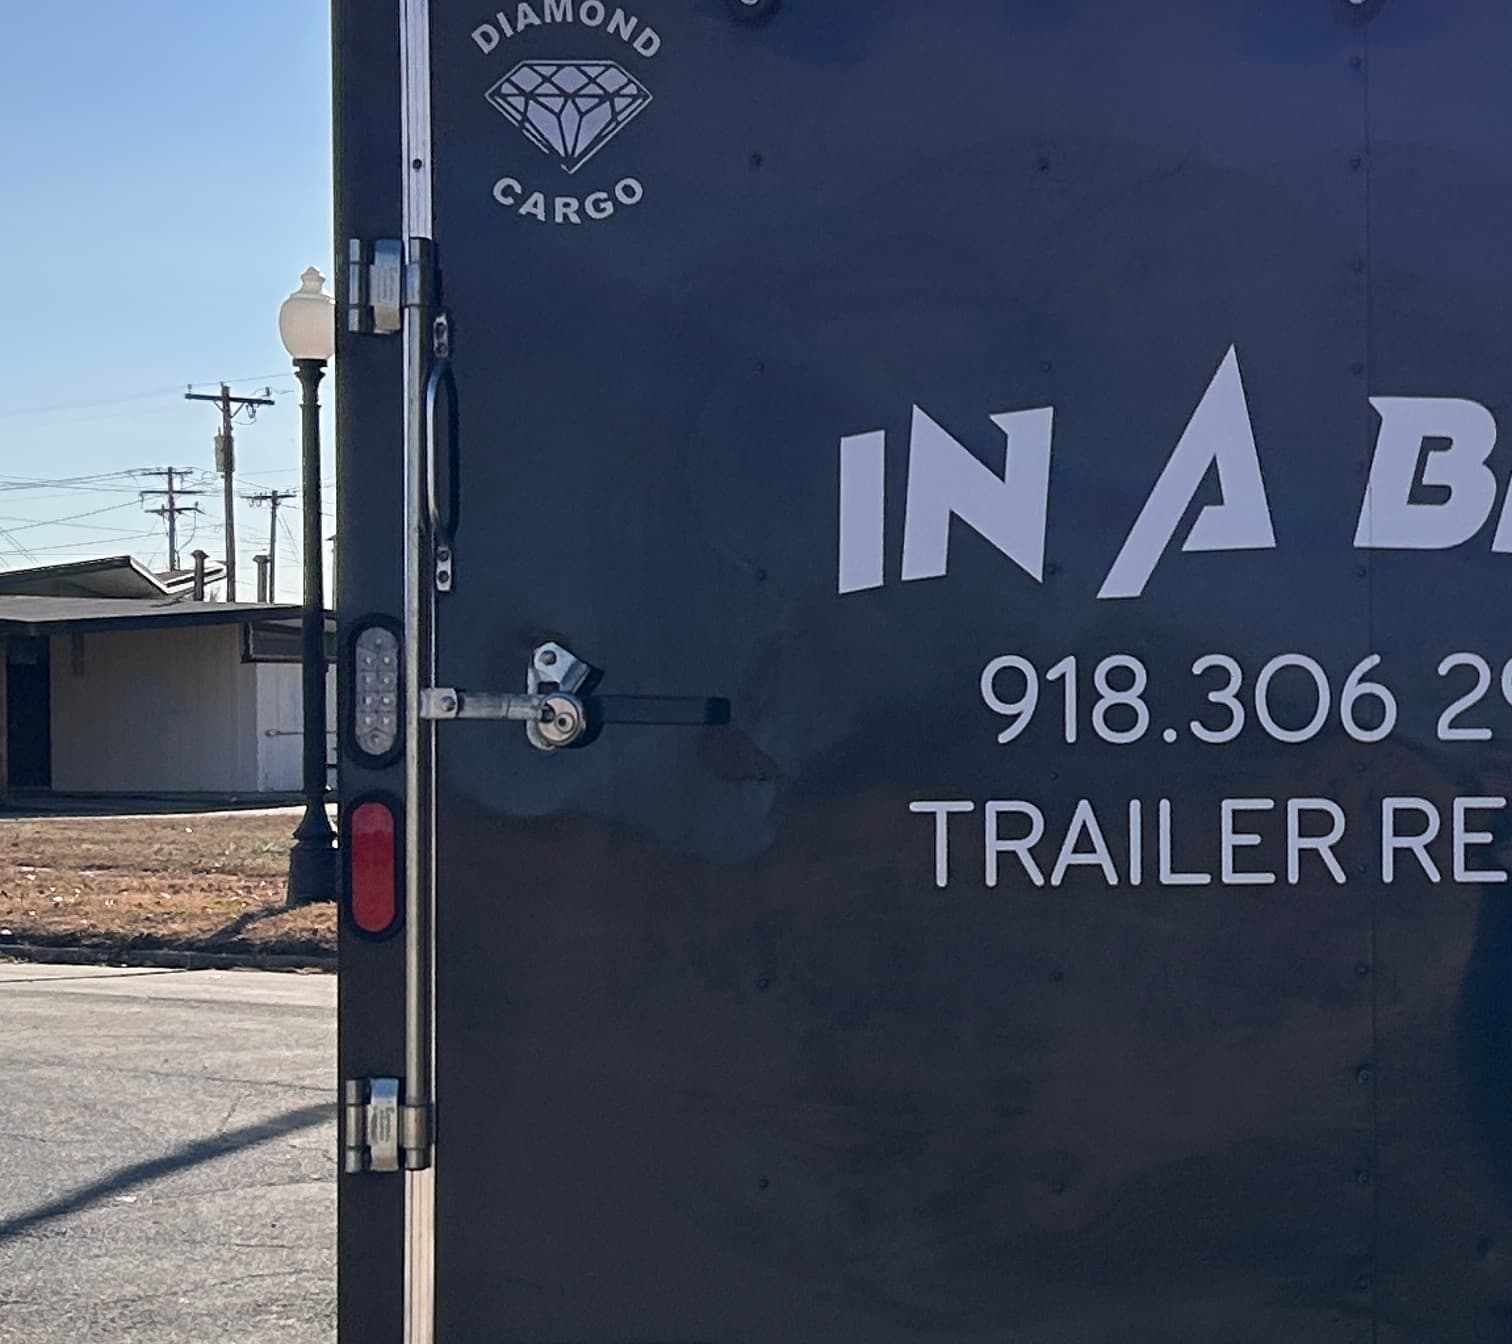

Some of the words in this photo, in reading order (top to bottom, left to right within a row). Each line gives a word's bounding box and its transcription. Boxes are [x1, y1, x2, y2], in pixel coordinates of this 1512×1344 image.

[492, 176, 643, 223] CARGO
[838, 404, 1054, 594] IN
[1096, 343, 1276, 599] A
[980, 654, 1397, 744] 918.306
[909, 798, 1346, 888] TRAILER
